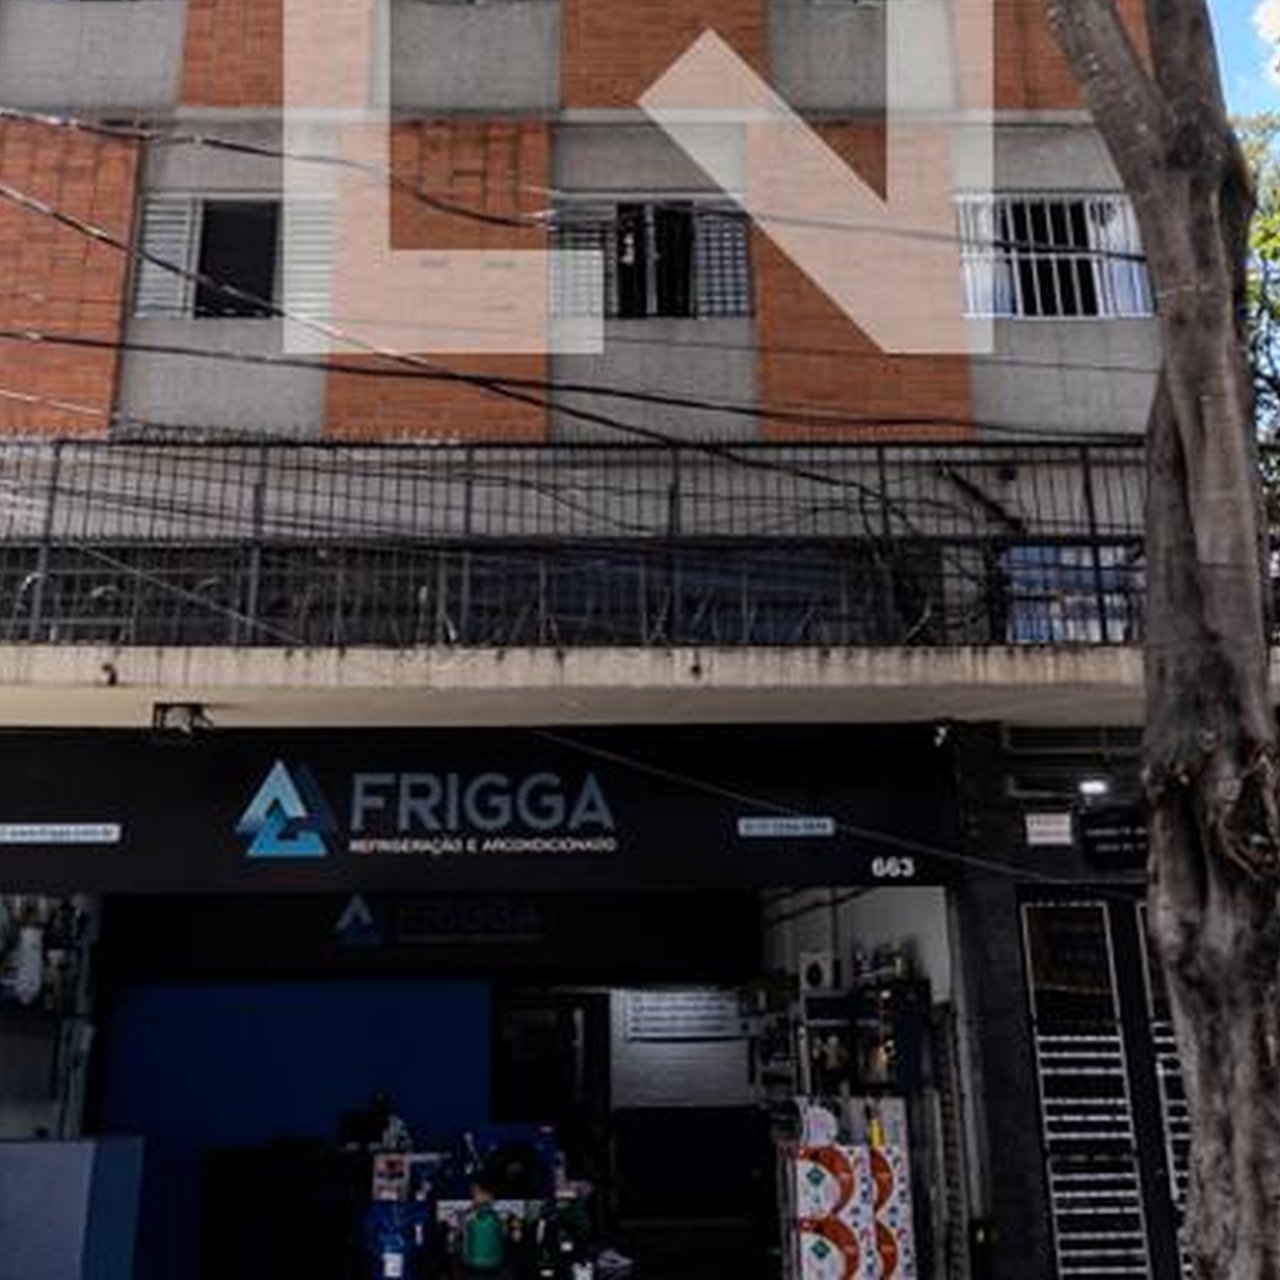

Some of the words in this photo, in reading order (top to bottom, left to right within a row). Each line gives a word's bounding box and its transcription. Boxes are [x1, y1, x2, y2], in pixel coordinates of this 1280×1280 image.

[349, 772, 616, 832] FRIGGA
[466, 837, 477, 853] E
[871, 856, 915, 878] 663
